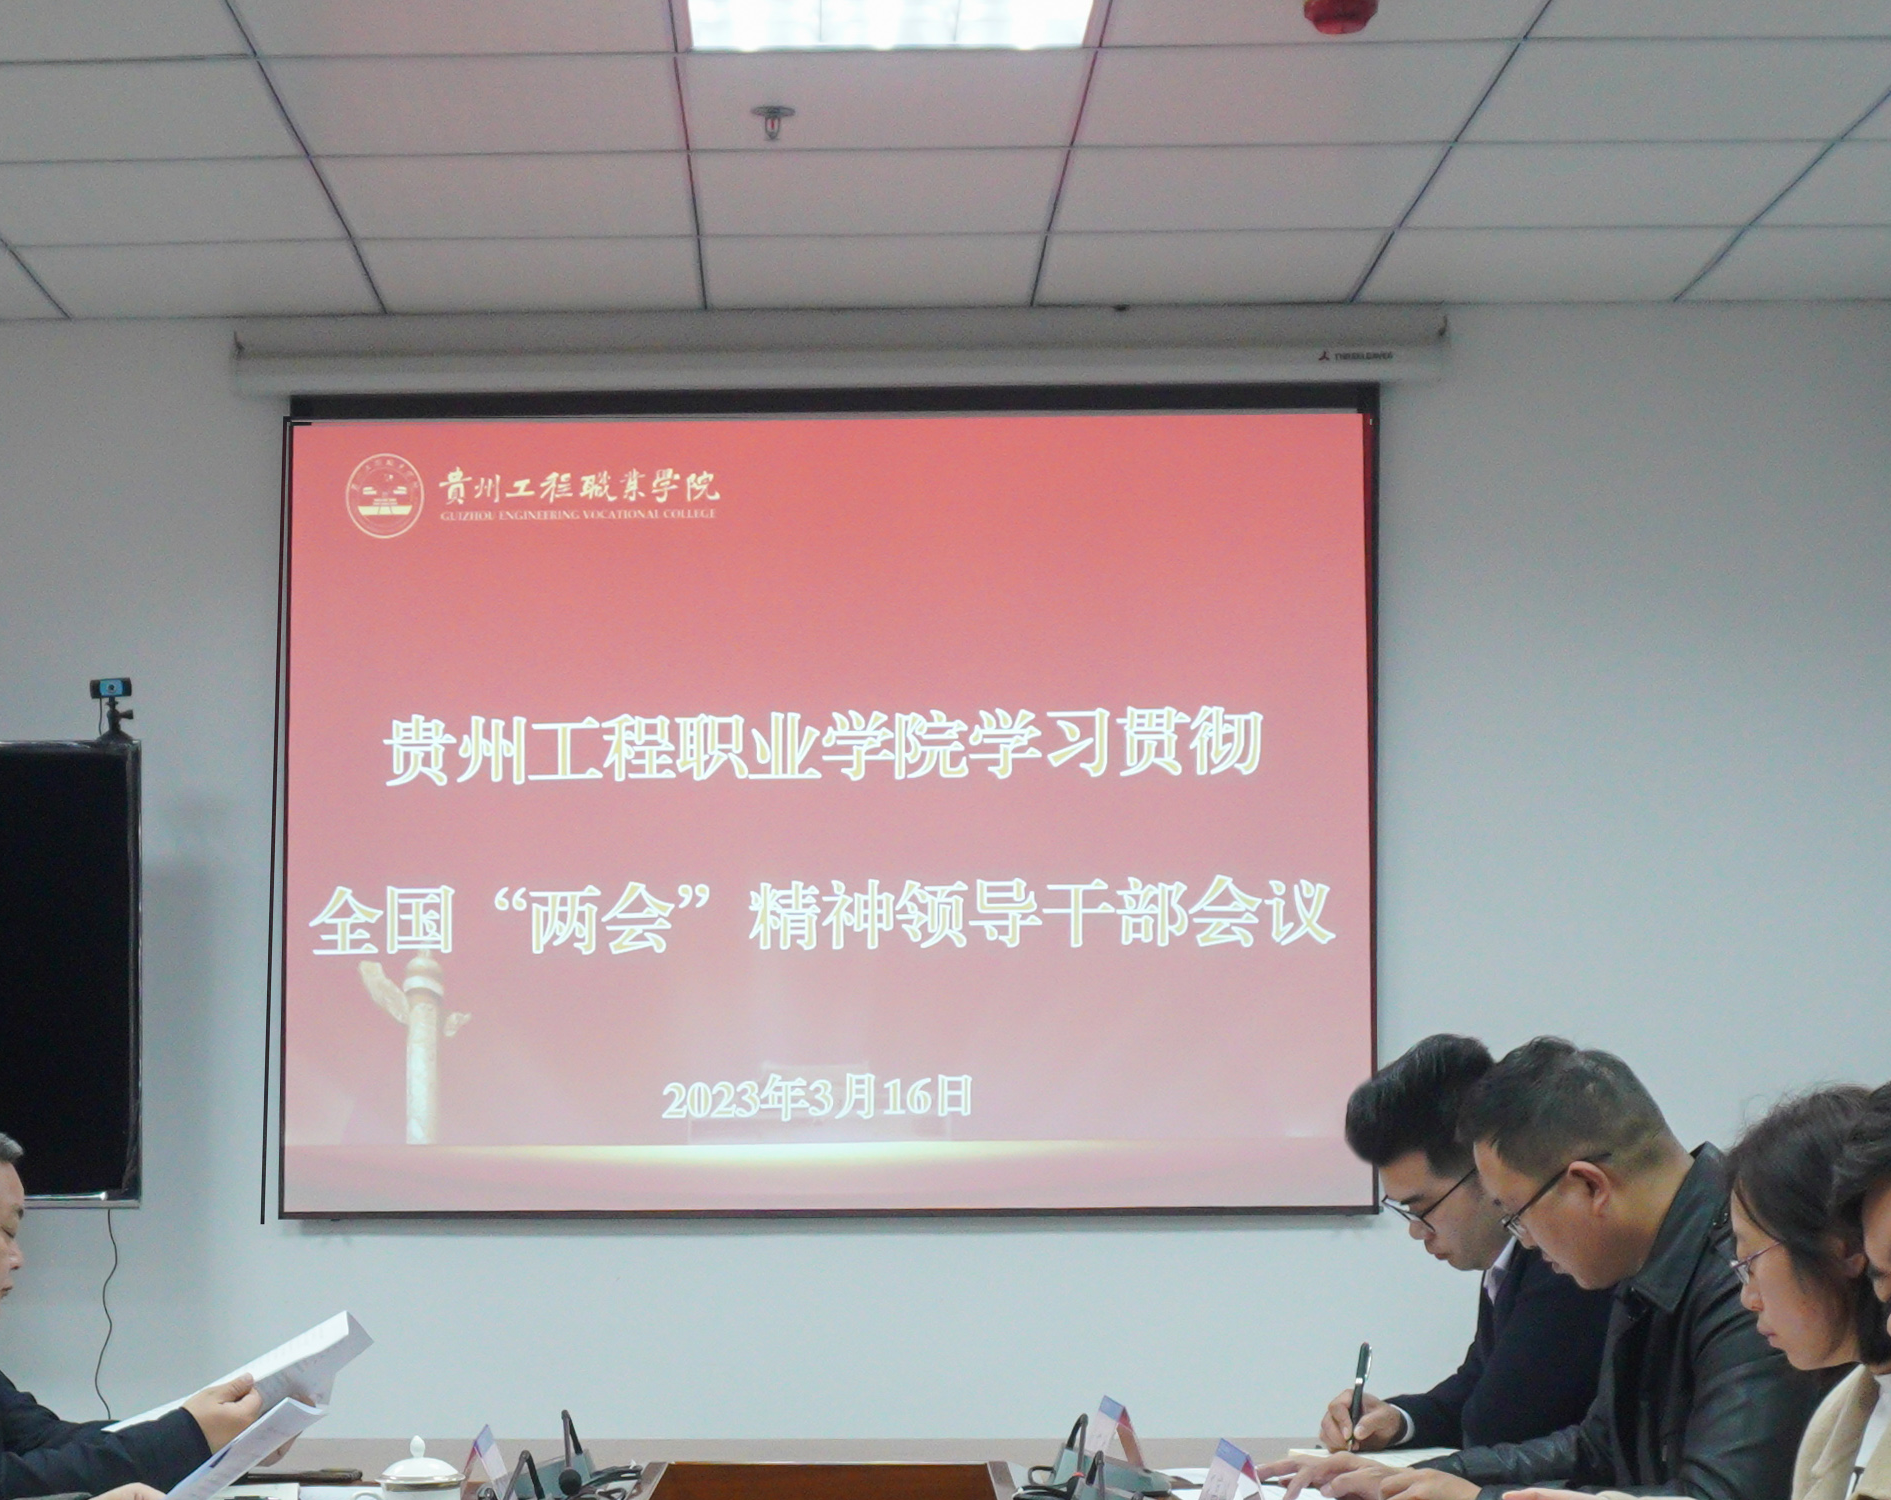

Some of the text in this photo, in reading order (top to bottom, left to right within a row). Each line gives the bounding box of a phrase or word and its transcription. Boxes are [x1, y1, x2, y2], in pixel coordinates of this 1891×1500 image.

[440, 508, 717, 521] GUIZHOU ENGINEERING VOCATIONAL COLLEGE
[382, 705, 1264, 787] 贵州工程职业学院学习贯彻
[661, 1072, 973, 1122] 2023年3月16日
